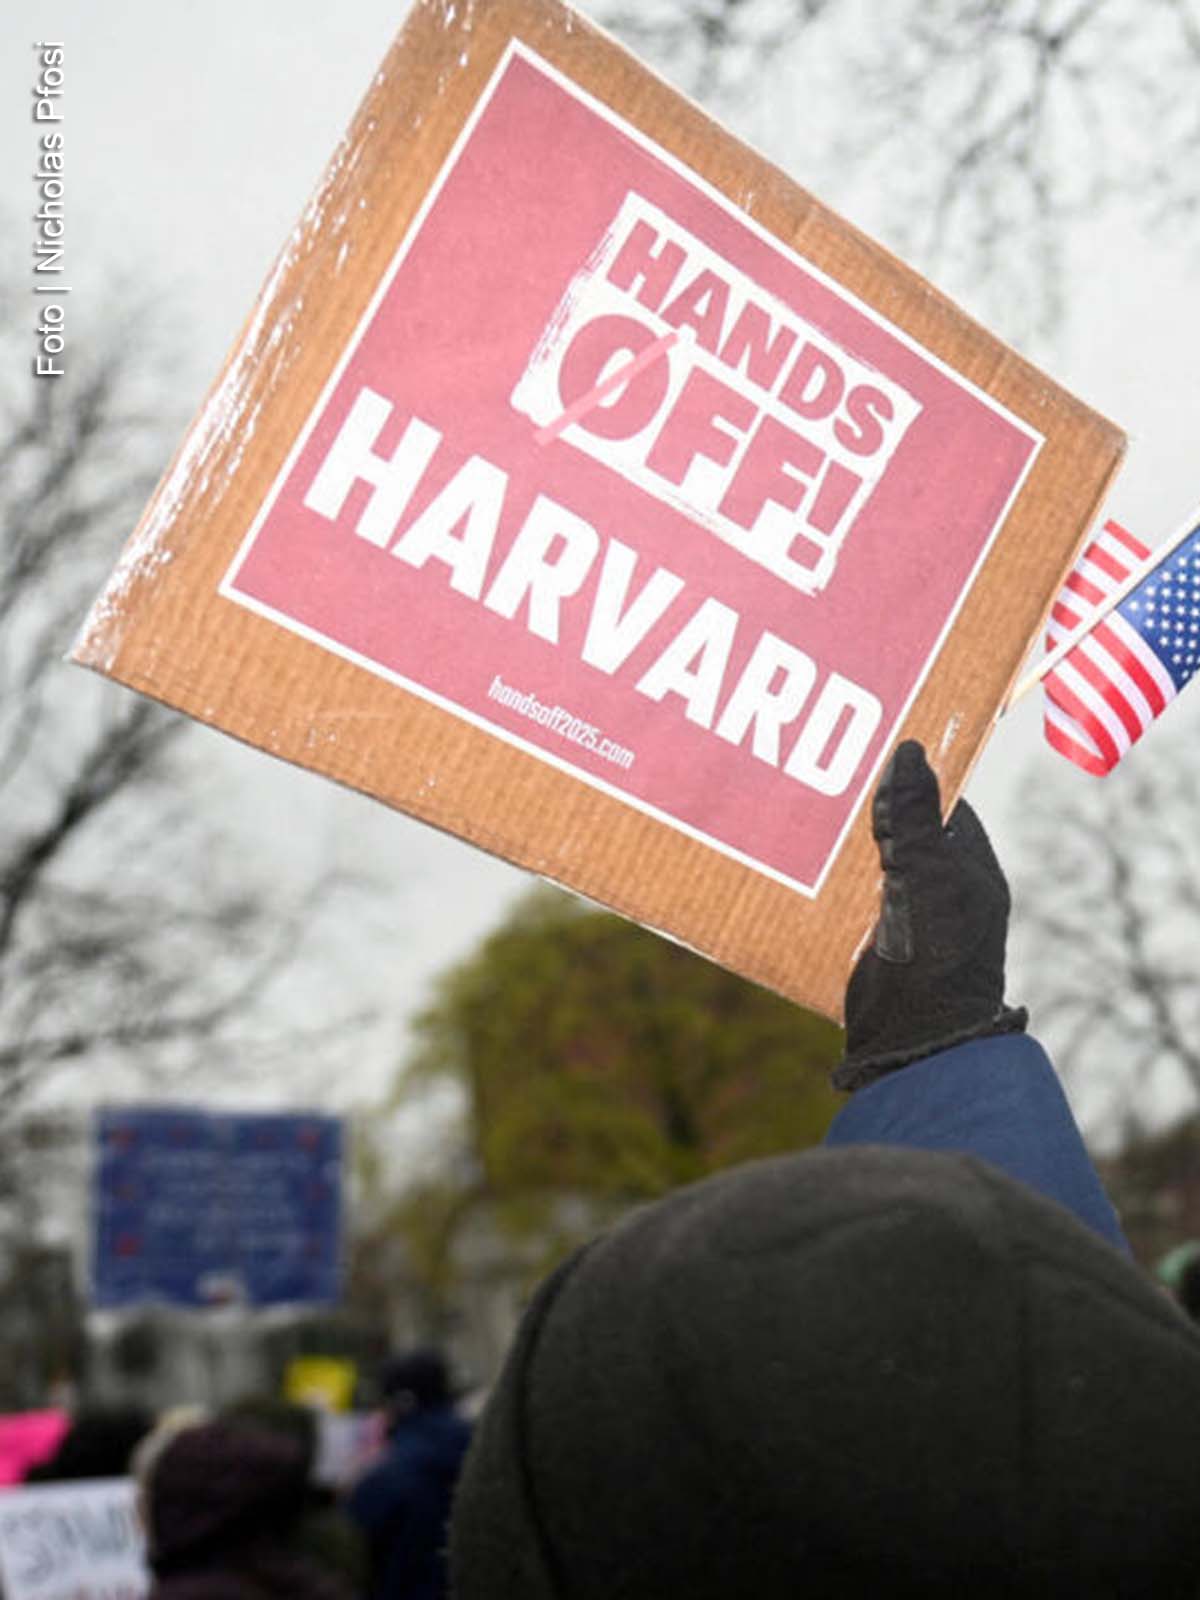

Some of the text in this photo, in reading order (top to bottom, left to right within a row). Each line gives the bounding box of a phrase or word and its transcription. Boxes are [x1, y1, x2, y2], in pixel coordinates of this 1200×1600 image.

[605, 218, 894, 458] HANDS
[303, 386, 883, 797] HARVARD
[487, 674, 636, 770] handsoff2025.com
